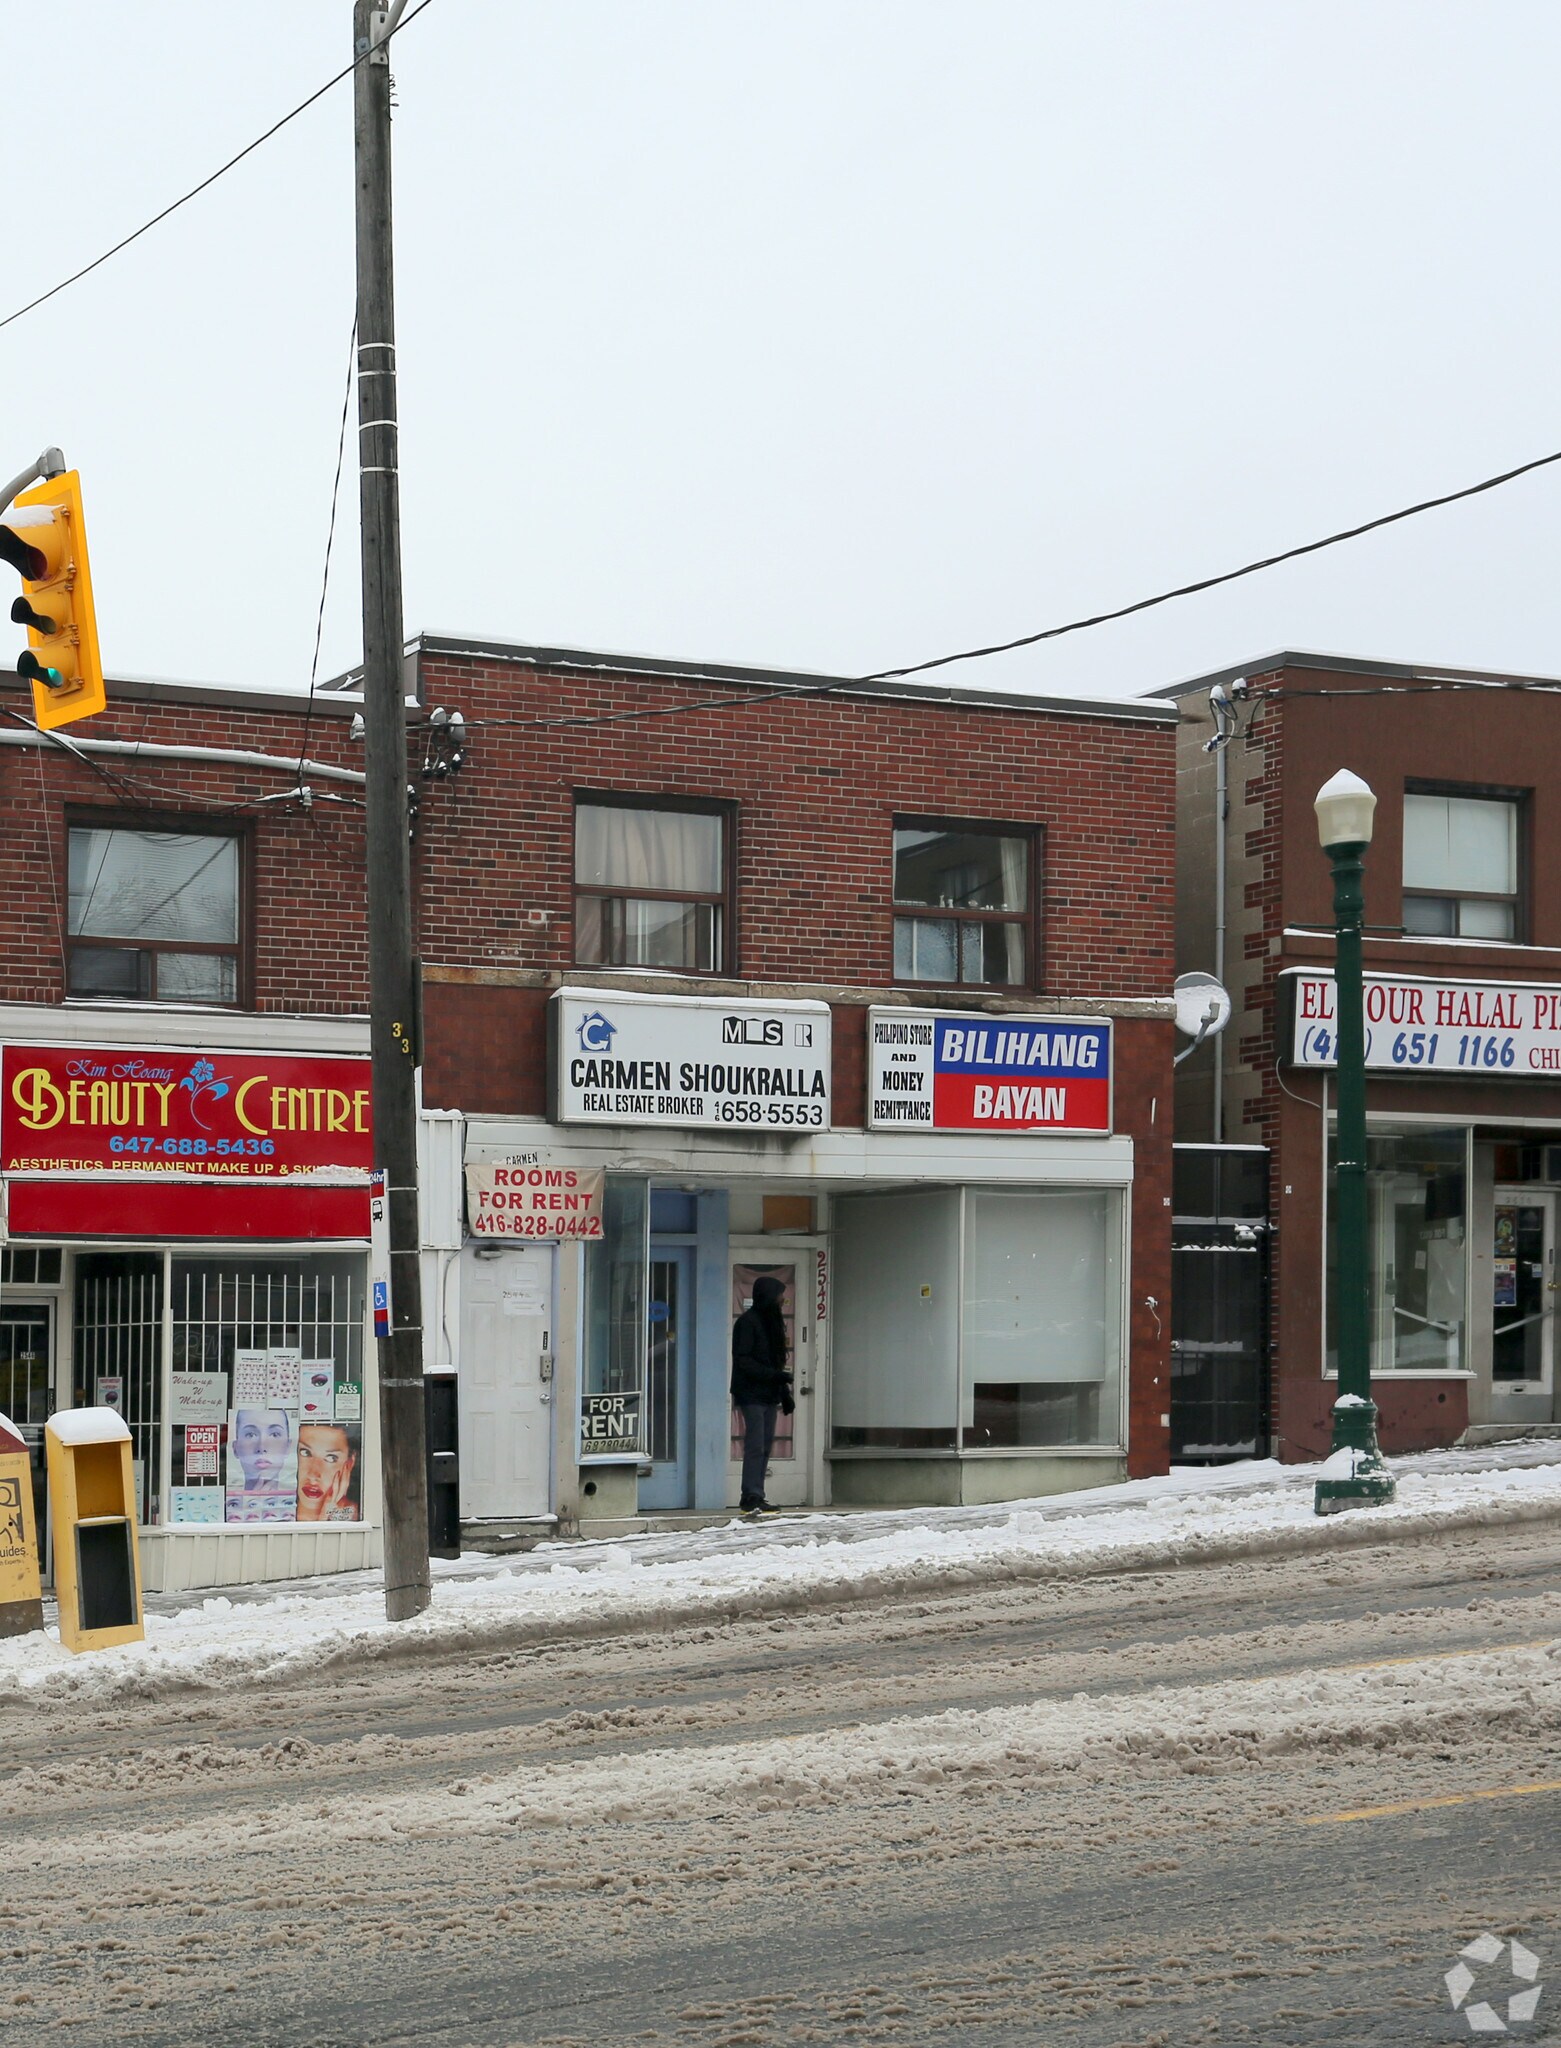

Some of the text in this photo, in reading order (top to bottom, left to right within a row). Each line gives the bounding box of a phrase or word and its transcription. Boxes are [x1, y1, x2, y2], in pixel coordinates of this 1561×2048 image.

[1363, 984, 1425, 1025] OUR
[1435, 990, 1522, 1029] HALAL
[1532, 994, 1561, 1031] PI
[874, 1023, 932, 1046] PHILIPINO STORE
[891, 1053, 917, 1062] AND
[941, 1029, 1099, 1068] BILIHANG
[1392, 1032, 1439, 1064] 651
[1459, 1034, 1515, 1068] 1166
[66, 1059, 174, 1084] Kim Hoang
[571, 1059, 826, 1098] CARMEN SHOUKRALLA
[882, 1070, 924, 1092] MONEY
[12, 1068, 370, 1135] BEAUTY CENTRE
[584, 1093, 703, 1115] REAL ESTATE BROKER
[874, 1100, 931, 1121] REMITTANCE
[973, 1085, 1066, 1121] BAYAN
[109, 1136, 275, 1156] 647-688-5436
[9, 1158, 104, 1170] AESTHETICS
[112, 1160, 205, 1173] PERMANENT
[207, 1163, 249, 1174] MAKE
[254, 1164, 274, 1174] UP
[279, 1166, 289, 1175] &
[506, 1151, 538, 1165] CARMEN
[494, 1169, 578, 1188] ROOMS
[479, 1191, 593, 1210] FOR RENT
[475, 1213, 600, 1236] 416-828-0442
[816, 1250, 826, 1320] 2542
[172, 1375, 213, 1388] Wake-up
[338, 1385, 358, 1394] PASS
[179, 1395, 223, 1408] Make-up
[590, 1397, 625, 1413] FOR
[581, 1413, 638, 1438] RENT
[190, 1432, 215, 1444] OPEN
